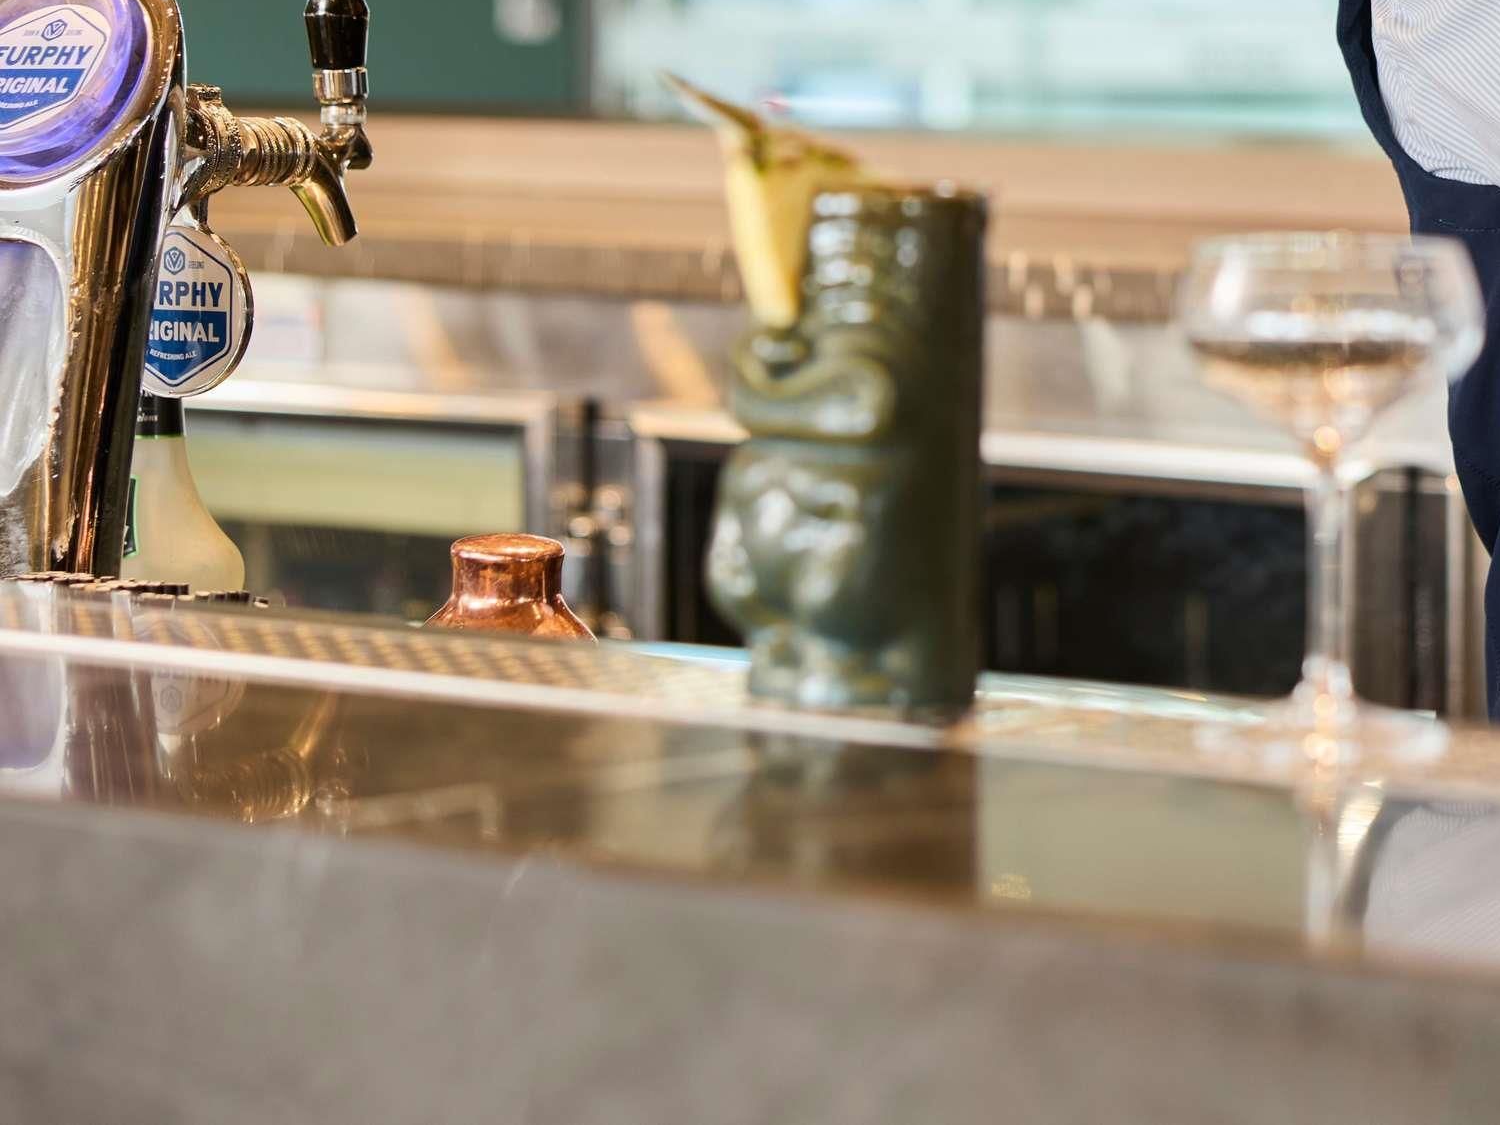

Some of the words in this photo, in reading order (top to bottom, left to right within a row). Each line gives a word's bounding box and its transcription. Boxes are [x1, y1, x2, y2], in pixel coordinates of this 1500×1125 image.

[0, 77, 69, 93] RIGINAL
[159, 280, 223, 307] RPHY
[148, 320, 219, 343] IGINAL
